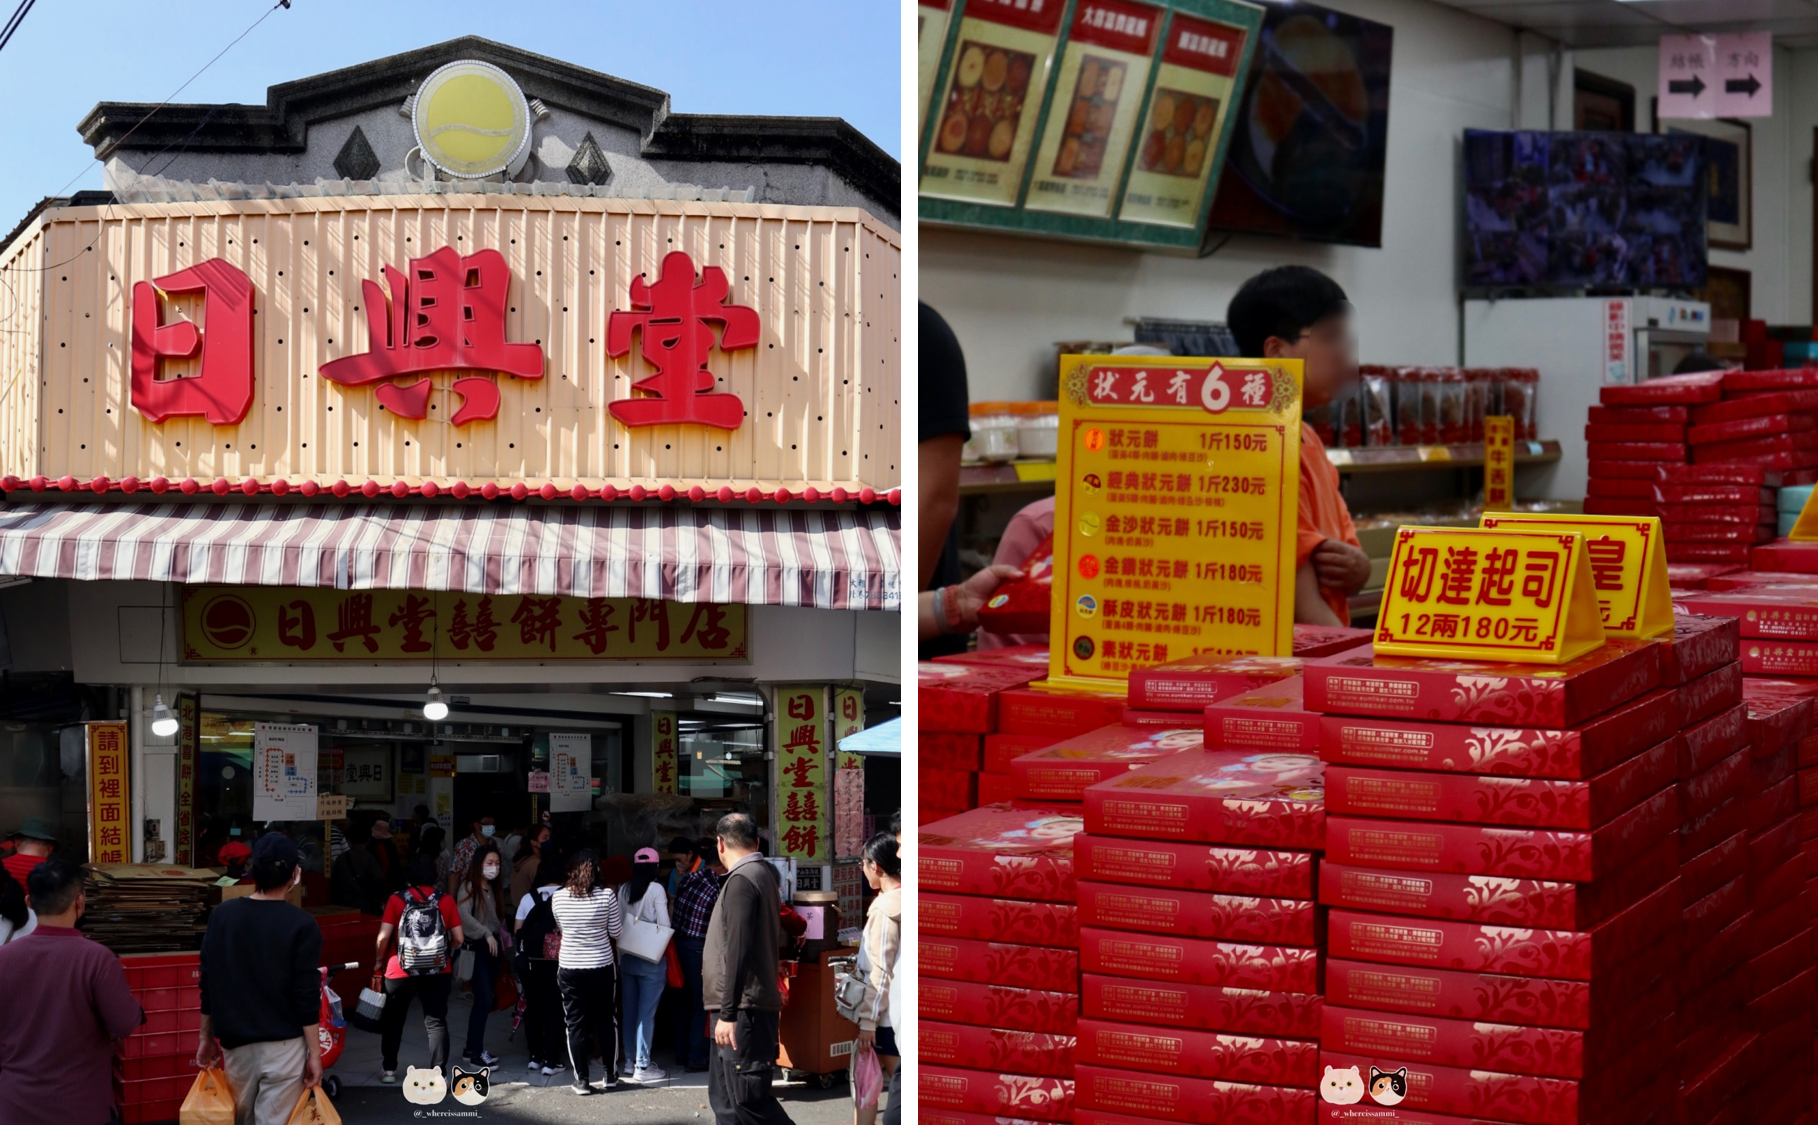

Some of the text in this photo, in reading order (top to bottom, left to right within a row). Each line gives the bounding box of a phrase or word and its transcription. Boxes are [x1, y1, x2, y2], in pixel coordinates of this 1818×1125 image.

[131, 245, 761, 428] 日興堂
[1108, 429, 1267, 452] 狀元餅 1斤150元
[1107, 471, 1192, 492] 經典狀元餅
[1198, 474, 1266, 495] 1斤230元
[1106, 514, 1264, 540] 金沙狀元餅 1斤150元
[1195, 562, 1262, 583] 1斤180元
[1400, 544, 1560, 608] 切達起司
[278, 593, 731, 655] 日興堂囍餅專門店
[1102, 599, 1261, 627] 酥皮狀元餅 1斤180元
[1401, 613, 1539, 642] 12兩180元
[1102, 640, 1168, 663] 素狀元餅
[781, 694, 821, 858] 日興堂囍餅
[98, 731, 122, 863] 請到裡面結帳
